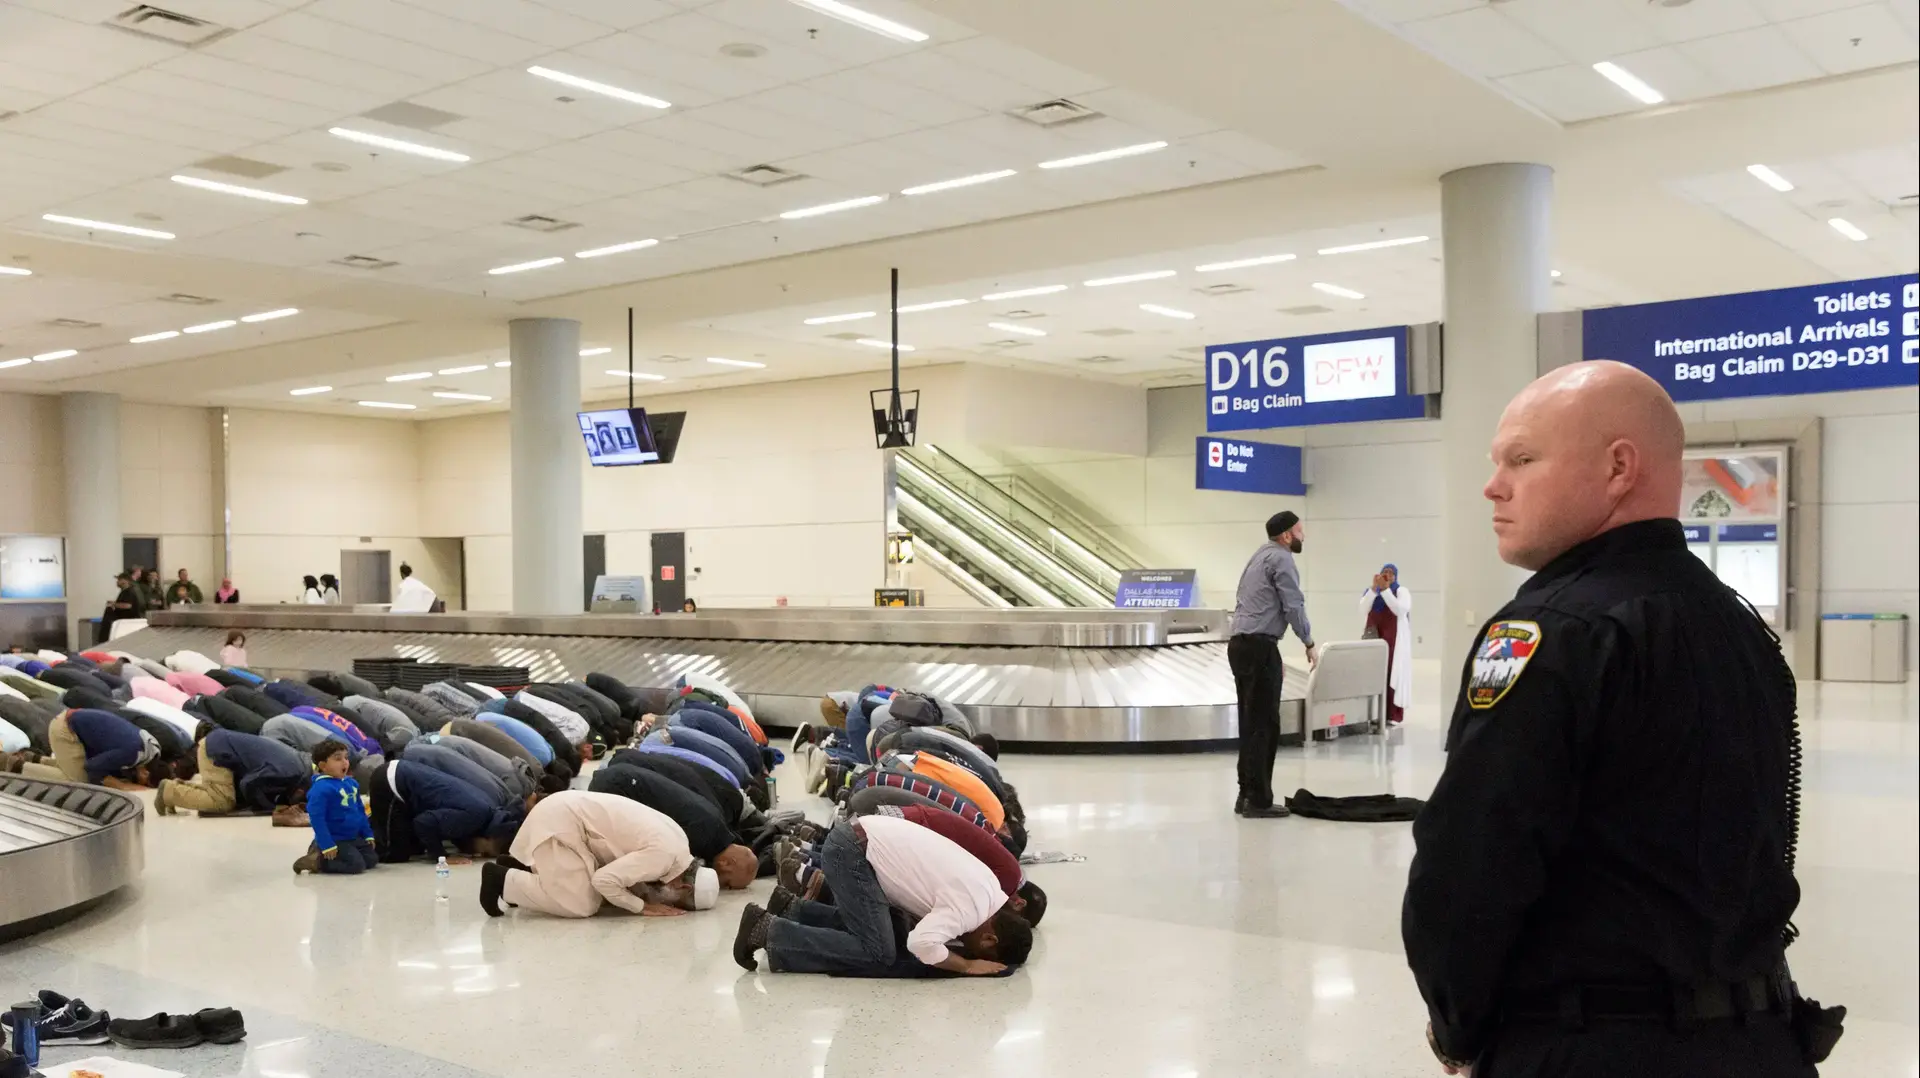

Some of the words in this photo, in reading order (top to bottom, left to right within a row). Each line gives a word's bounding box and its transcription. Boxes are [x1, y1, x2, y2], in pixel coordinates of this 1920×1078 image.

[1814, 291, 1891, 315] Toilets
[1655, 326, 1793, 357] International
[1799, 318, 1890, 344] Arrivals
[1211, 346, 1290, 391] D16
[1315, 355, 1383, 386] DFW
[1675, 362, 1716, 382] Bag
[1722, 356, 1785, 376] Claim
[1792, 345, 1889, 371] D29-D31
[1232, 397, 1260, 413] Bag
[1263, 394, 1302, 409] Claim
[1227, 443, 1239, 457] Do
[1239, 444, 1254, 458] Not
[1227, 460, 1248, 473] Enter
